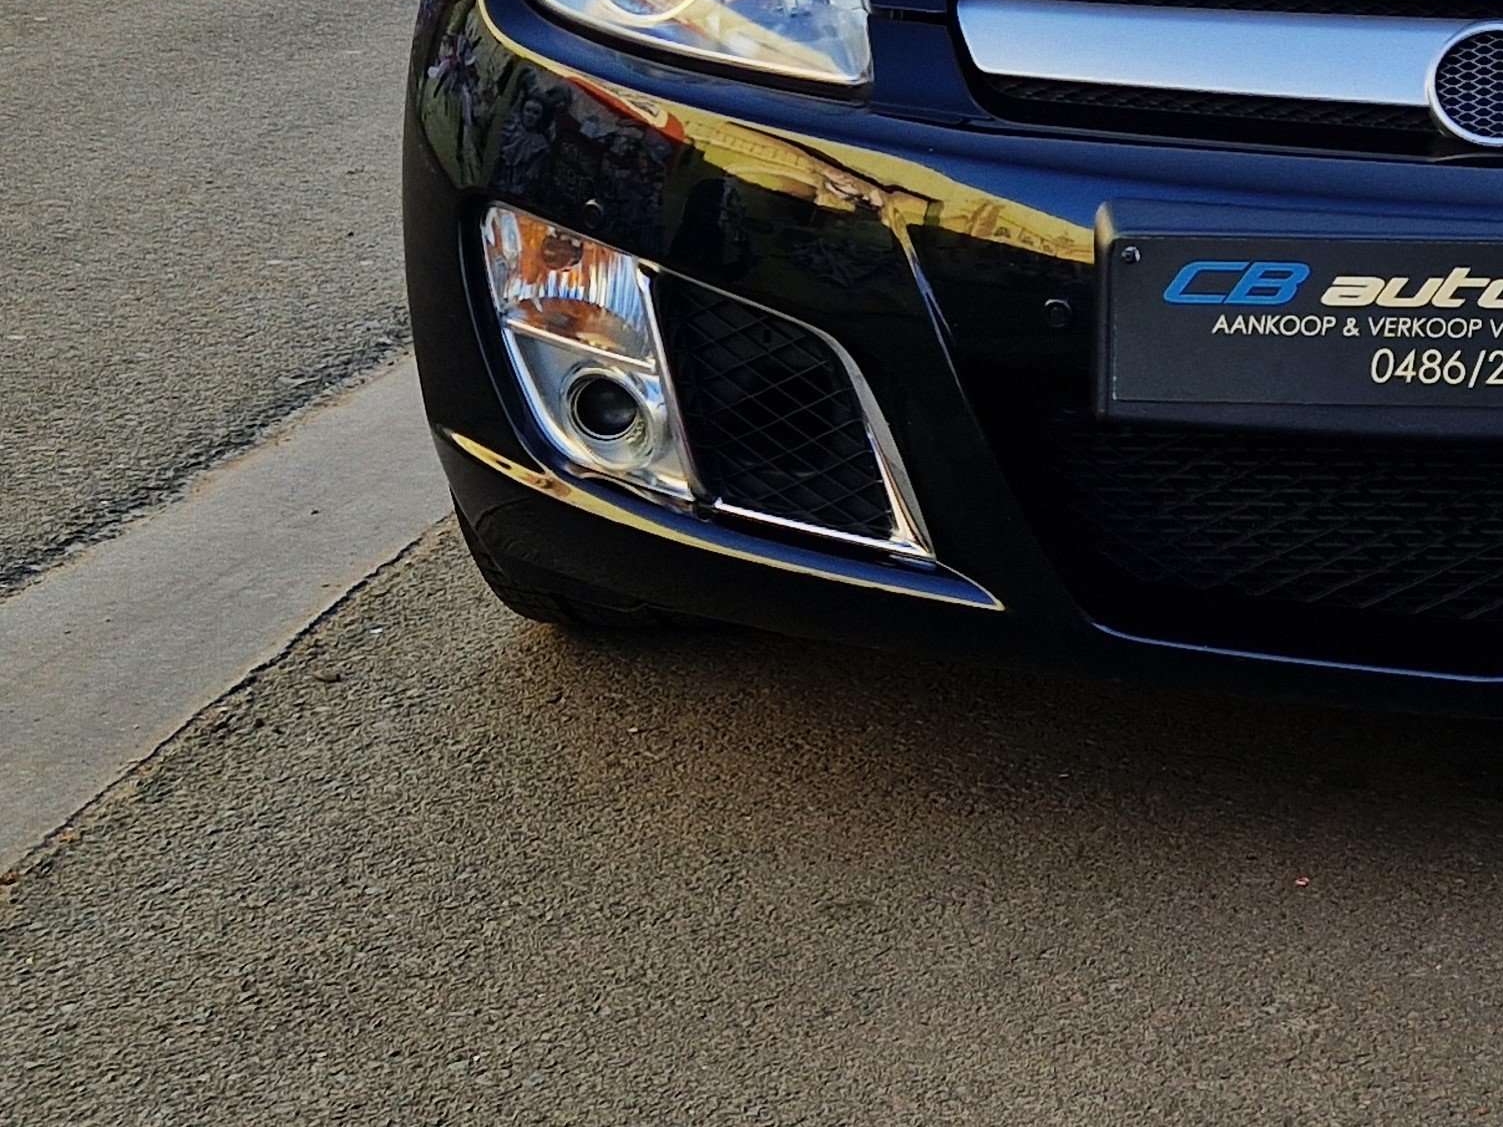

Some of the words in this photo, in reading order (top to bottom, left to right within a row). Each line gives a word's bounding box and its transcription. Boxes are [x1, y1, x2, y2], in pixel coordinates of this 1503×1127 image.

[1162, 261, 1311, 305] CB
[1211, 314, 1337, 336] AANKOOP
[1342, 317, 1360, 337] &
[1367, 316, 1483, 339] VERKOOP
